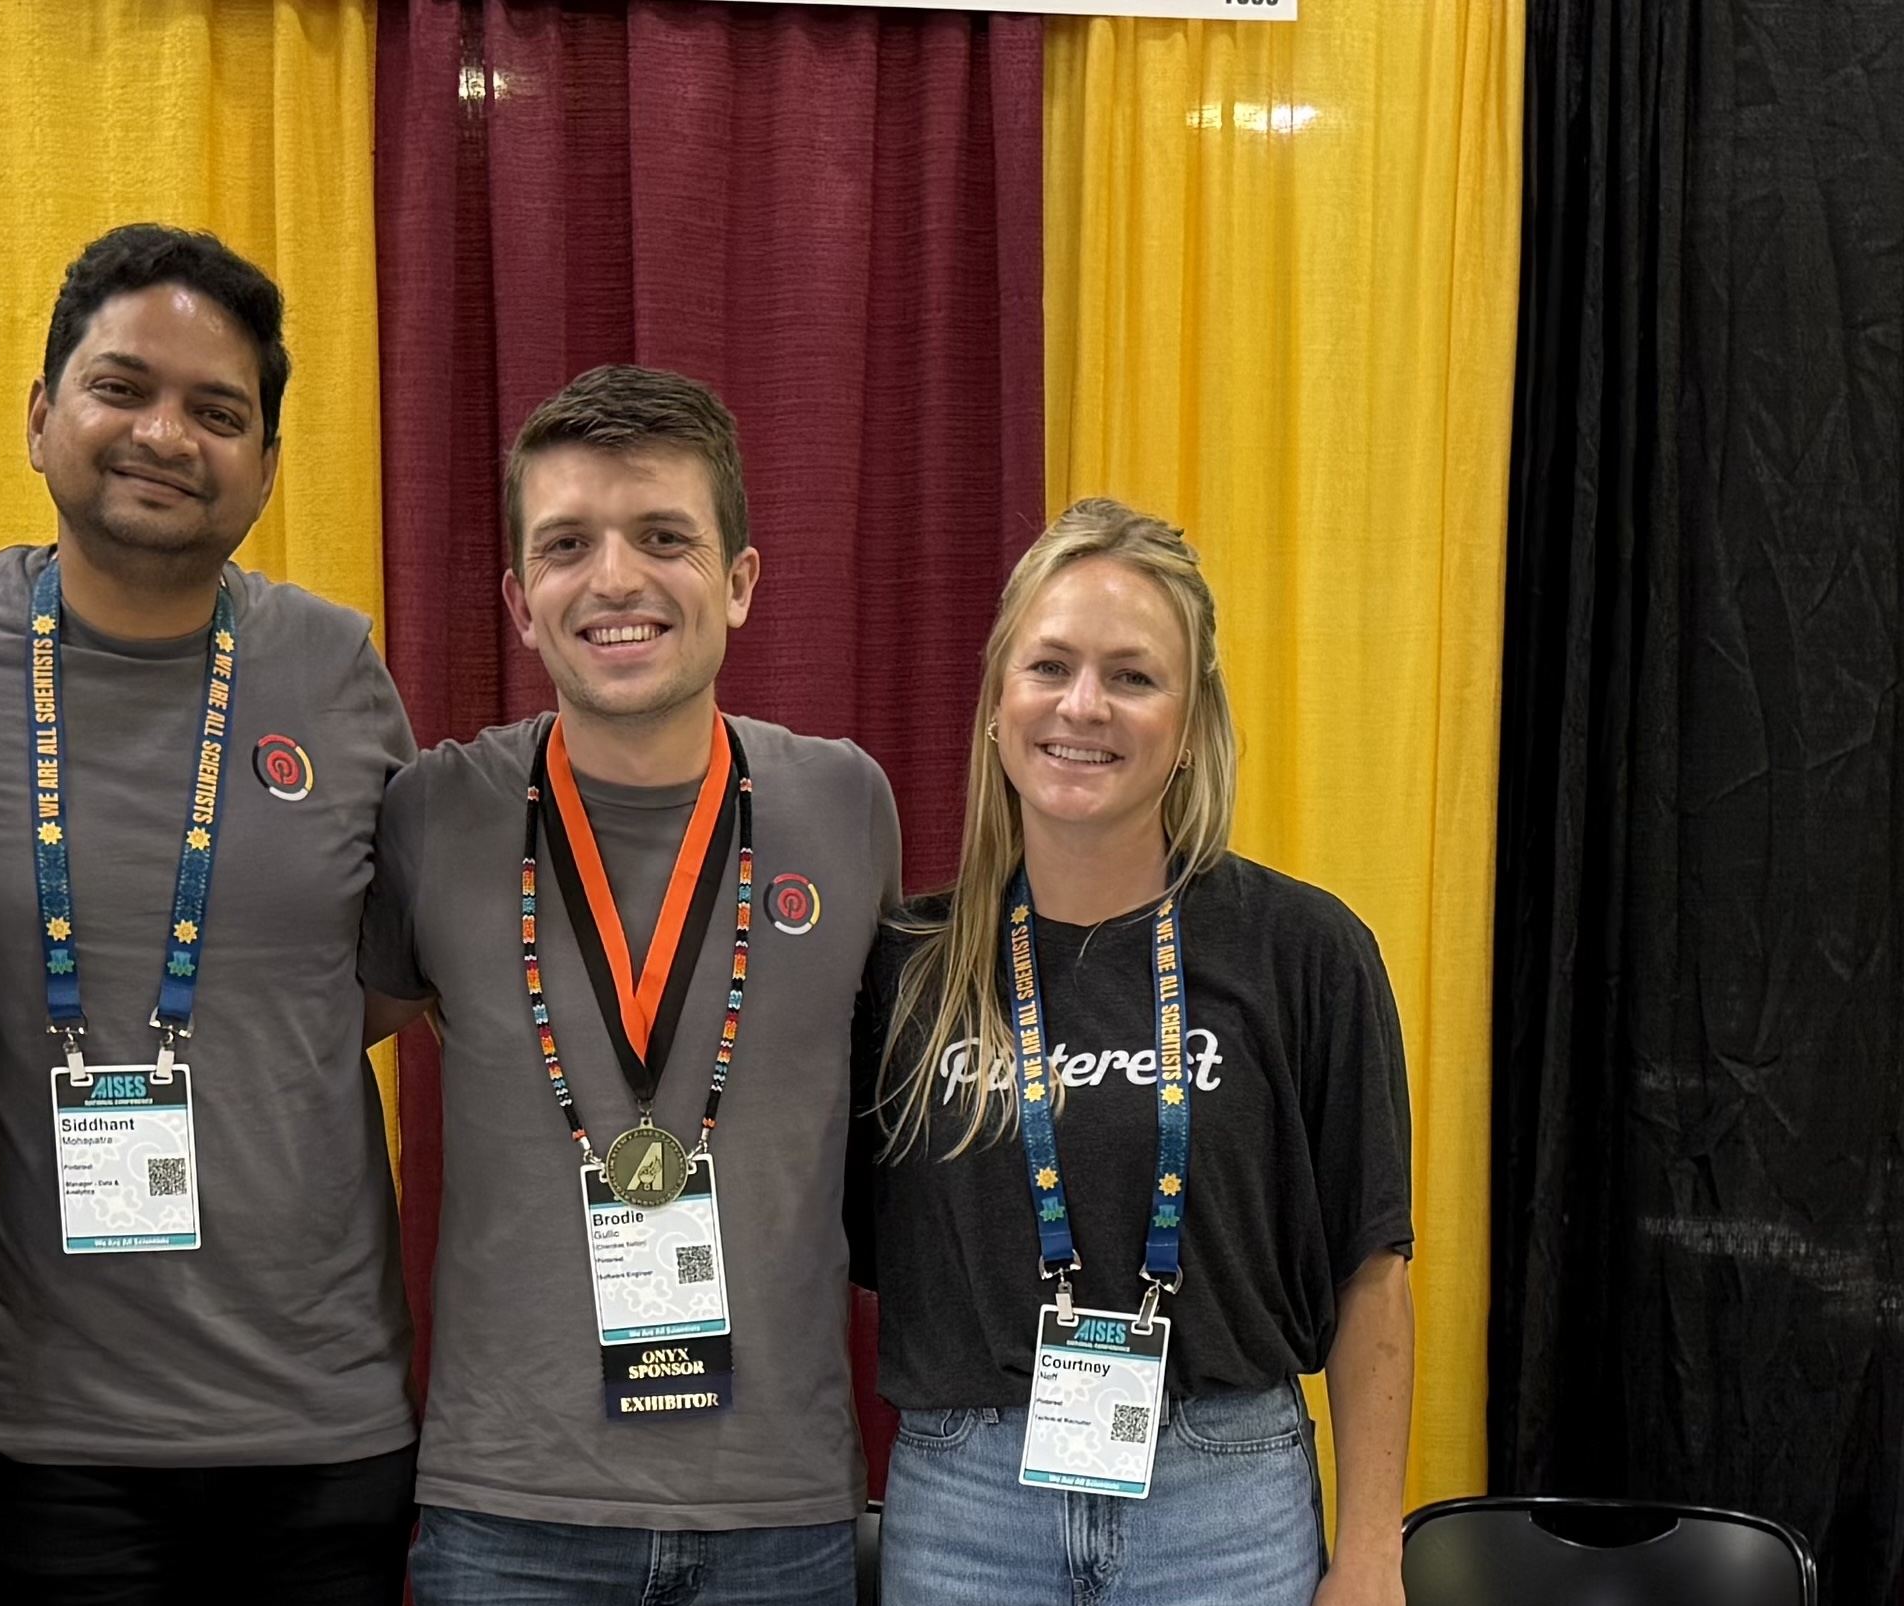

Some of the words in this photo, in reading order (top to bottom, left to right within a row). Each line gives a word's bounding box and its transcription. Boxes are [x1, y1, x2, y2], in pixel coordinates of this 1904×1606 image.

[212, 653, 233, 680] WE
[33, 638, 56, 723] SCIENTISTS
[208, 678, 229, 711] ARE
[204, 709, 226, 738] ALL
[36, 727, 58, 755] ALL
[37, 759, 58, 789] ARE
[192, 740, 223, 825] SCIENTISTS
[38, 793, 59, 818] WE
[1156, 918, 1174, 944] WE
[1011, 925, 1035, 1001] SCIENTISTS
[1157, 945, 1177, 974] ARE
[1159, 975, 1179, 1002] ALL
[1018, 1000, 1038, 1026] ALL
[1020, 1027, 1042, 1055] ARE
[1161, 1004, 1182, 1081] SCIENTISTS
[1024, 1056, 1044, 1081] WE
[91, 1075, 147, 1099] AISES
[61, 1118, 135, 1133] Siddhant
[592, 1210, 644, 1227] Brodie
[1074, 1319, 1127, 1344] AISES
[642, 1348, 689, 1364] ONYX
[1041, 1354, 1111, 1377] Courtney
[628, 1361, 705, 1379] SPONSOR
[620, 1393, 719, 1412] EXHIBITOR
